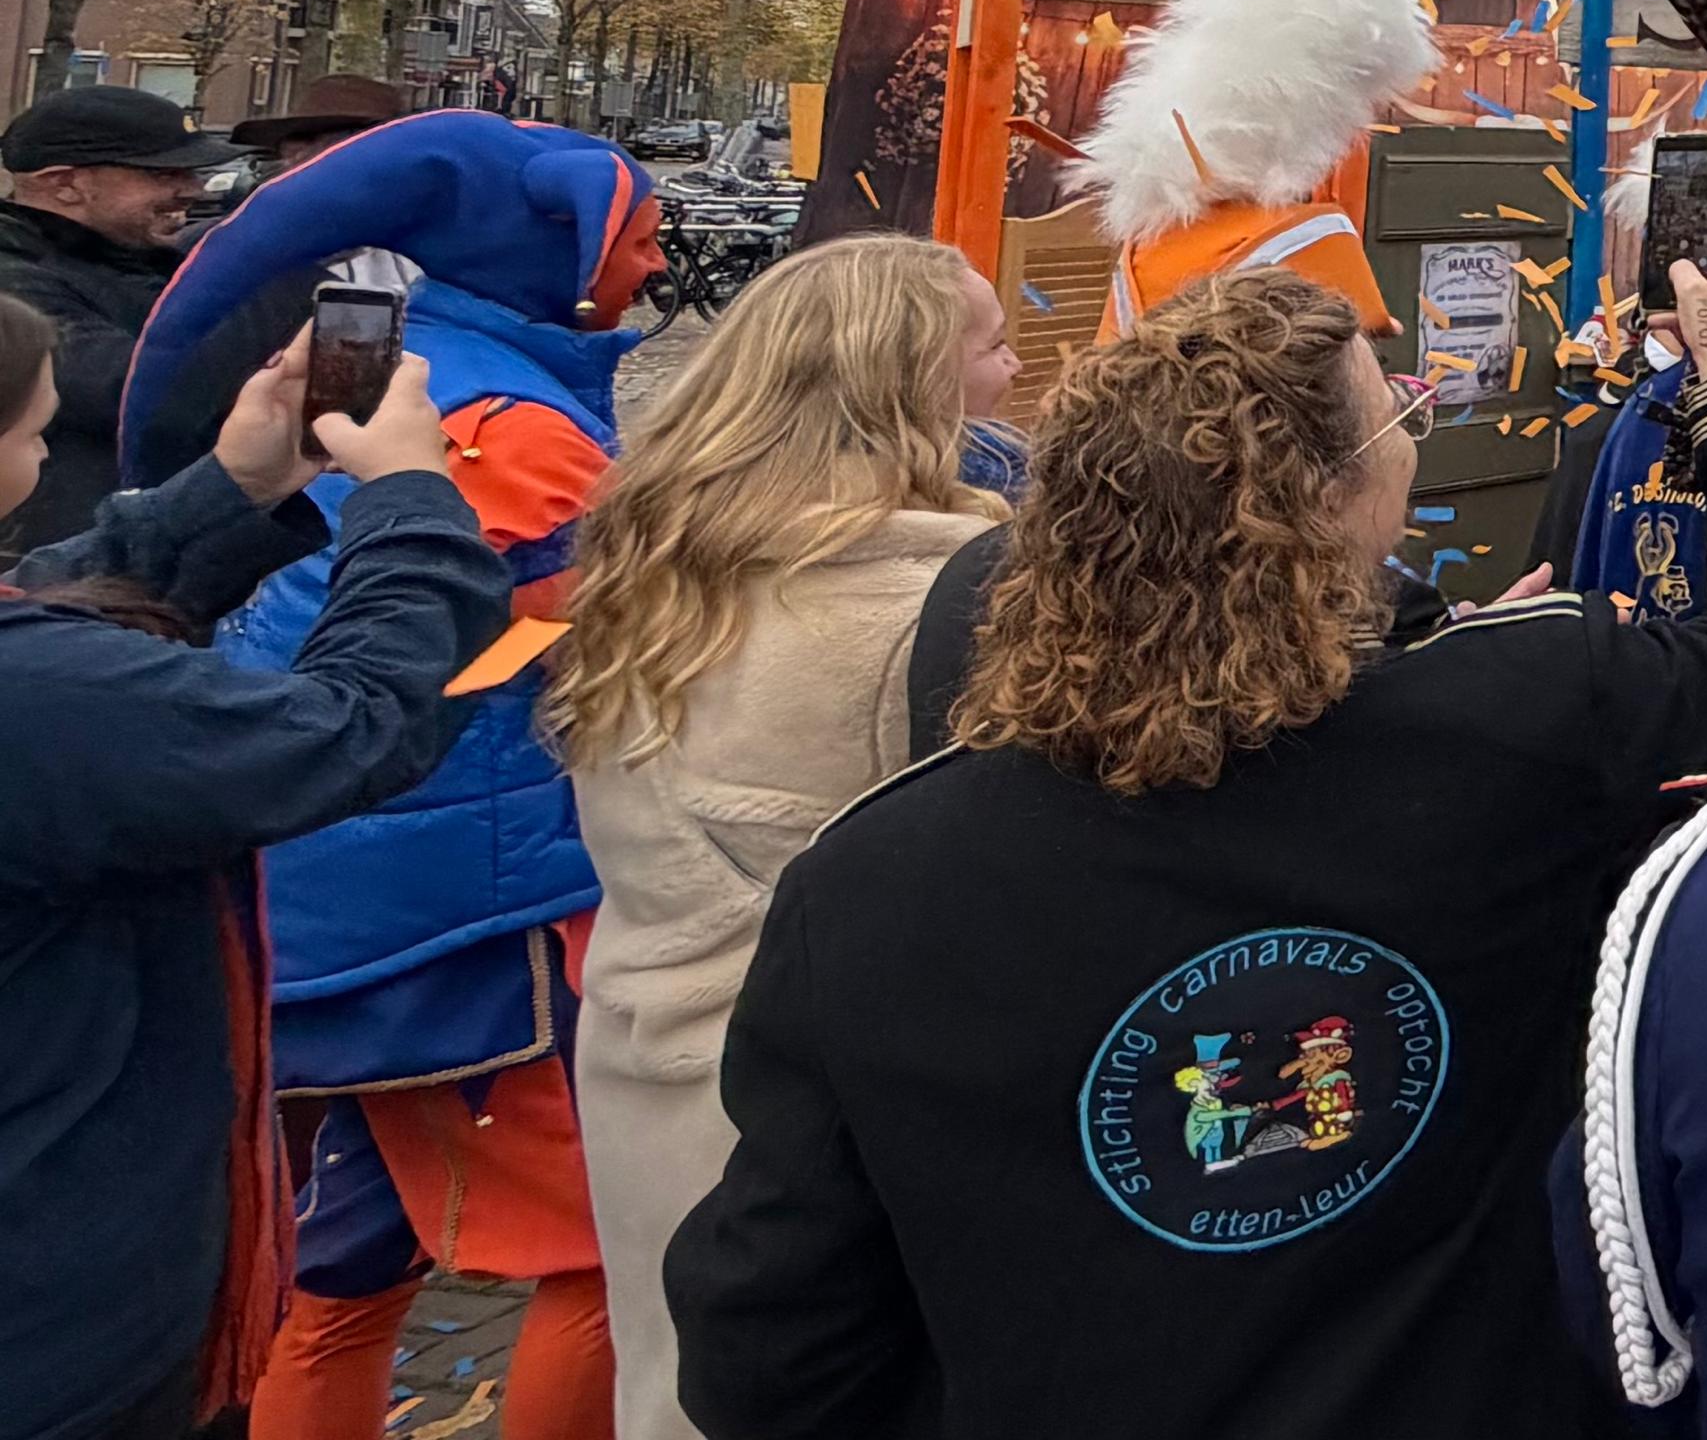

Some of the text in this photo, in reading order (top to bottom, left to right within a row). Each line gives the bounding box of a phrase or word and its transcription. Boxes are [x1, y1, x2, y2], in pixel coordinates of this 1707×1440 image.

[1093, 938, 1433, 1195] stichting carnavals optocht
[1189, 1160, 1380, 1238] etten-leur
